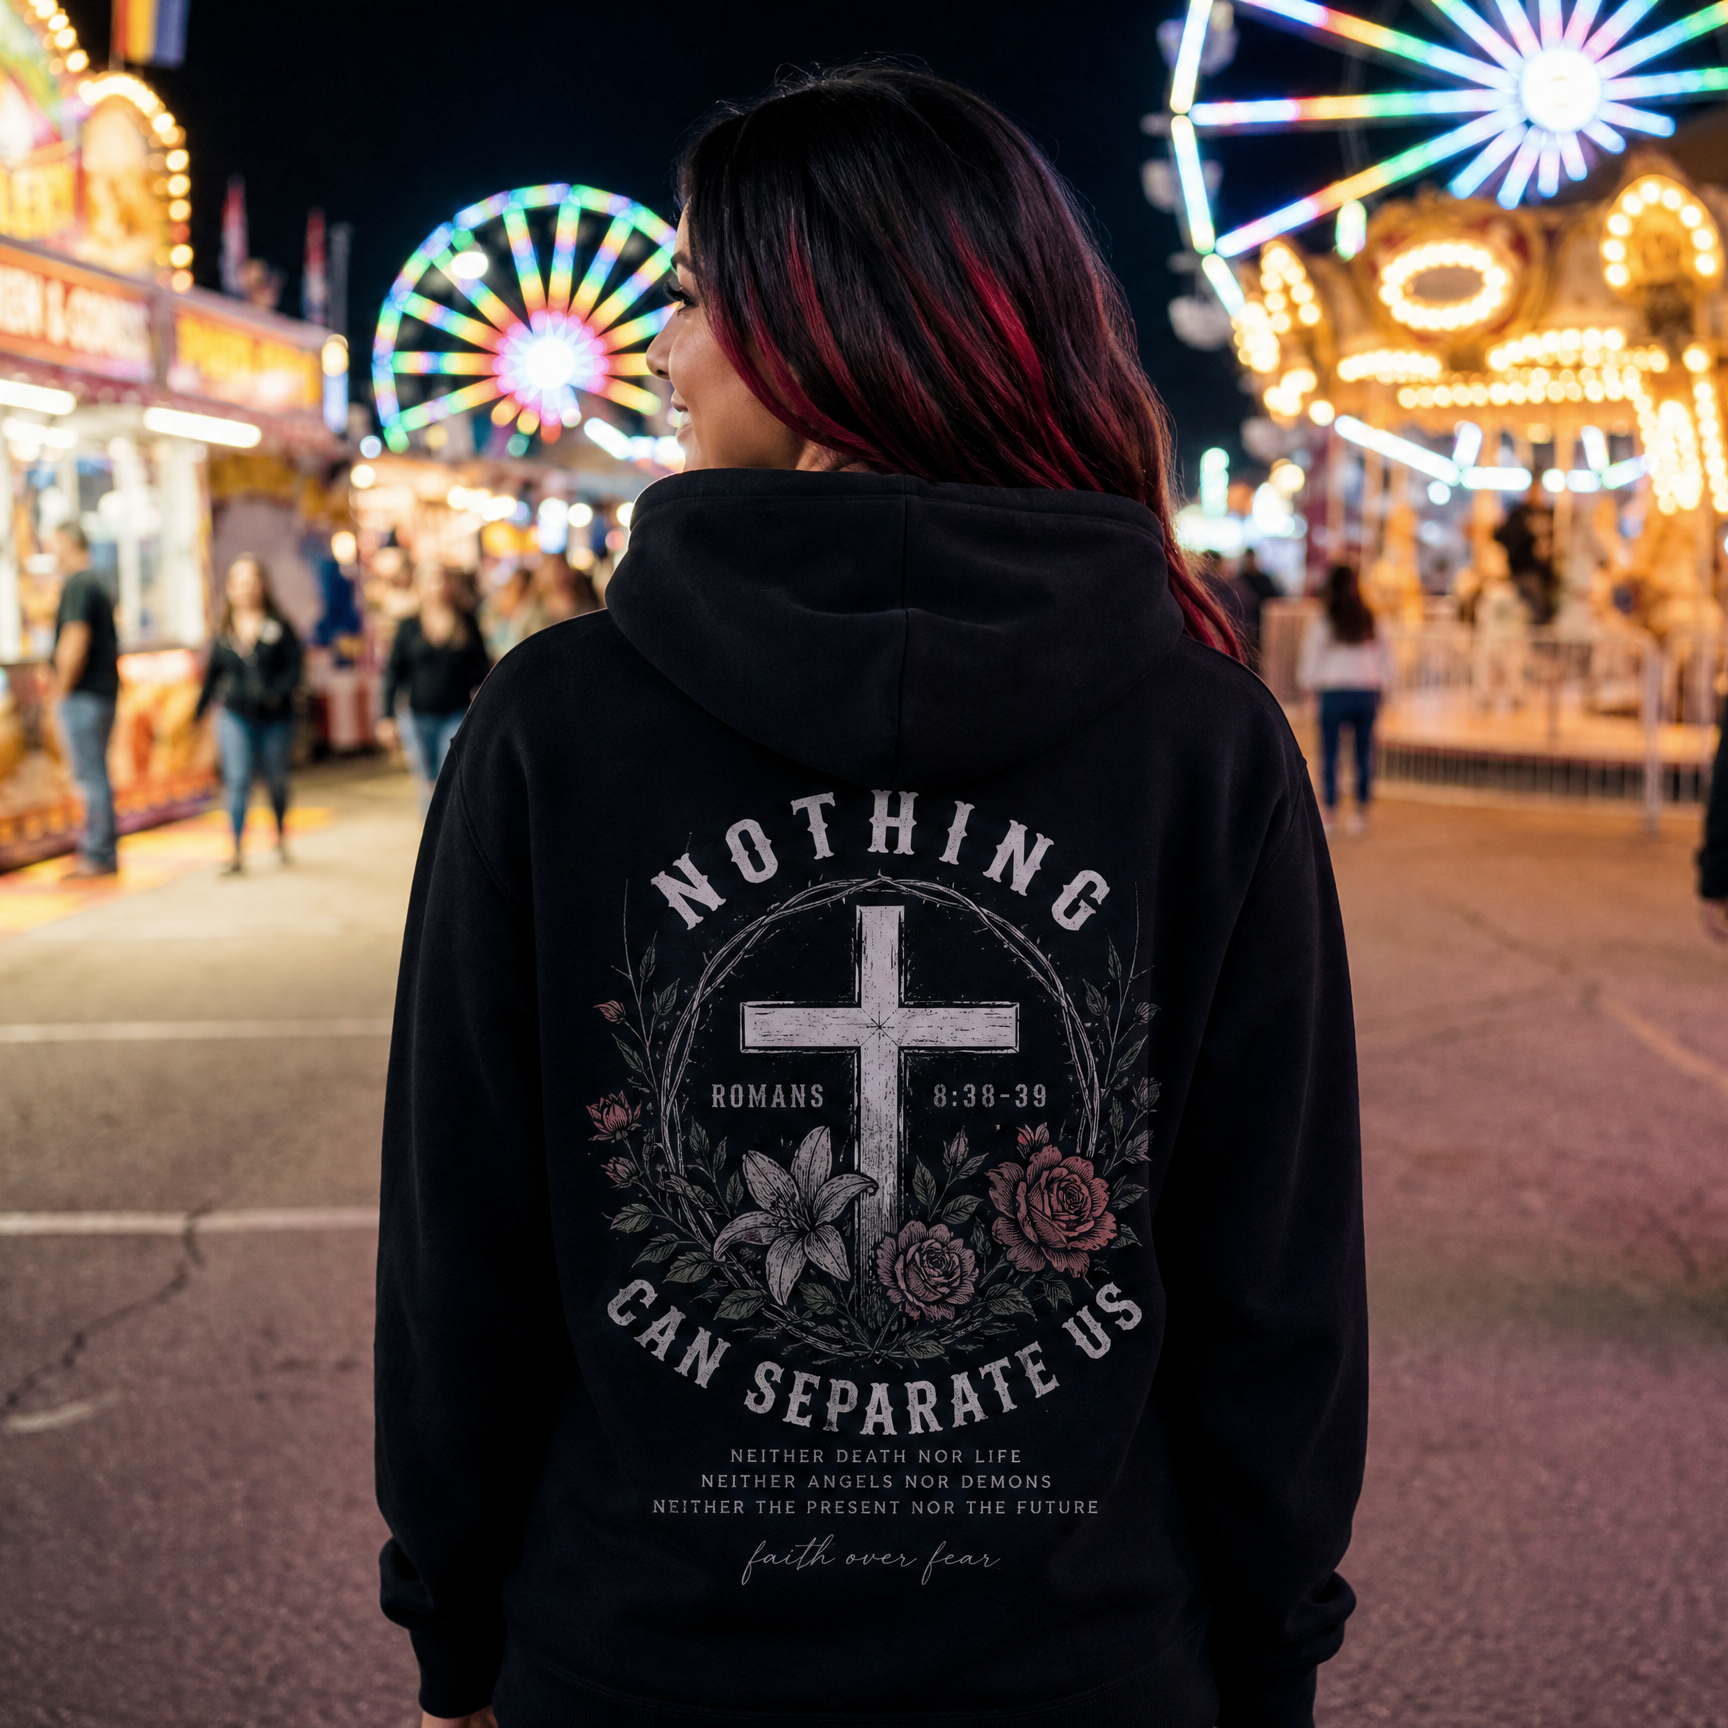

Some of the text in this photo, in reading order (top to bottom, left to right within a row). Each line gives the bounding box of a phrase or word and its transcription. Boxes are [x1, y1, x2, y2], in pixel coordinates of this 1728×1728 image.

[651, 789, 1110, 930] NOTHING
[711, 1083, 1047, 1108] ROMANS 8:38-39
[607, 1279, 1143, 1435] CAN SEPARATE US
[730, 1448, 1021, 1464] NEITHER DEATH NOR LIFE
[701, 1474, 1051, 1489] NEITHER ANGELS NOR DEMONS
[652, 1499, 1098, 1515] NEITHER THE PRESENT NOR THE FUTURE
[740, 1533, 1001, 1586] faith over fear
